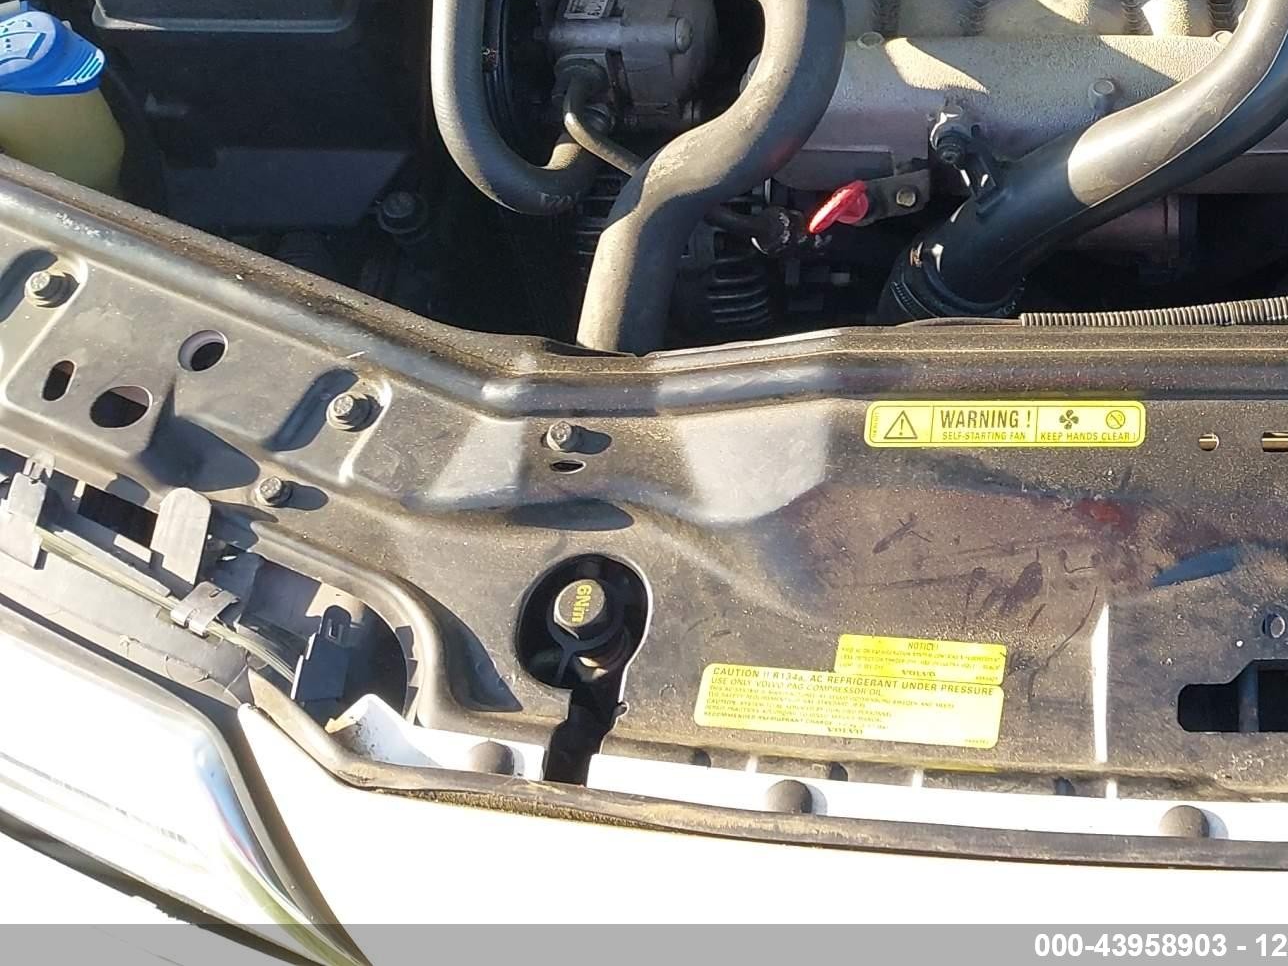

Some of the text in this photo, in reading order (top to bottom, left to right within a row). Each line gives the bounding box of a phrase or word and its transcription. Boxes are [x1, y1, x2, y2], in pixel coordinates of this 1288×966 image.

[940, 409, 1019, 429] WARNING
[942, 431, 1026, 441] SELF-STARTING FAN
[1040, 431, 1062, 441] KEEP
[1066, 431, 1099, 441] HANDS
[1101, 431, 1131, 441] CLEAR
[711, 677, 726, 685] USE
[756, 680, 784, 688] VOLVO
[806, 683, 869, 695] COMPRESSOR
[713, 667, 759, 678] CAUTION
[809, 674, 823, 683] AC
[827, 676, 898, 689] REFRIGERANT
[901, 681, 937, 692] UNDER
[940, 685, 993, 696] PRESSURE
